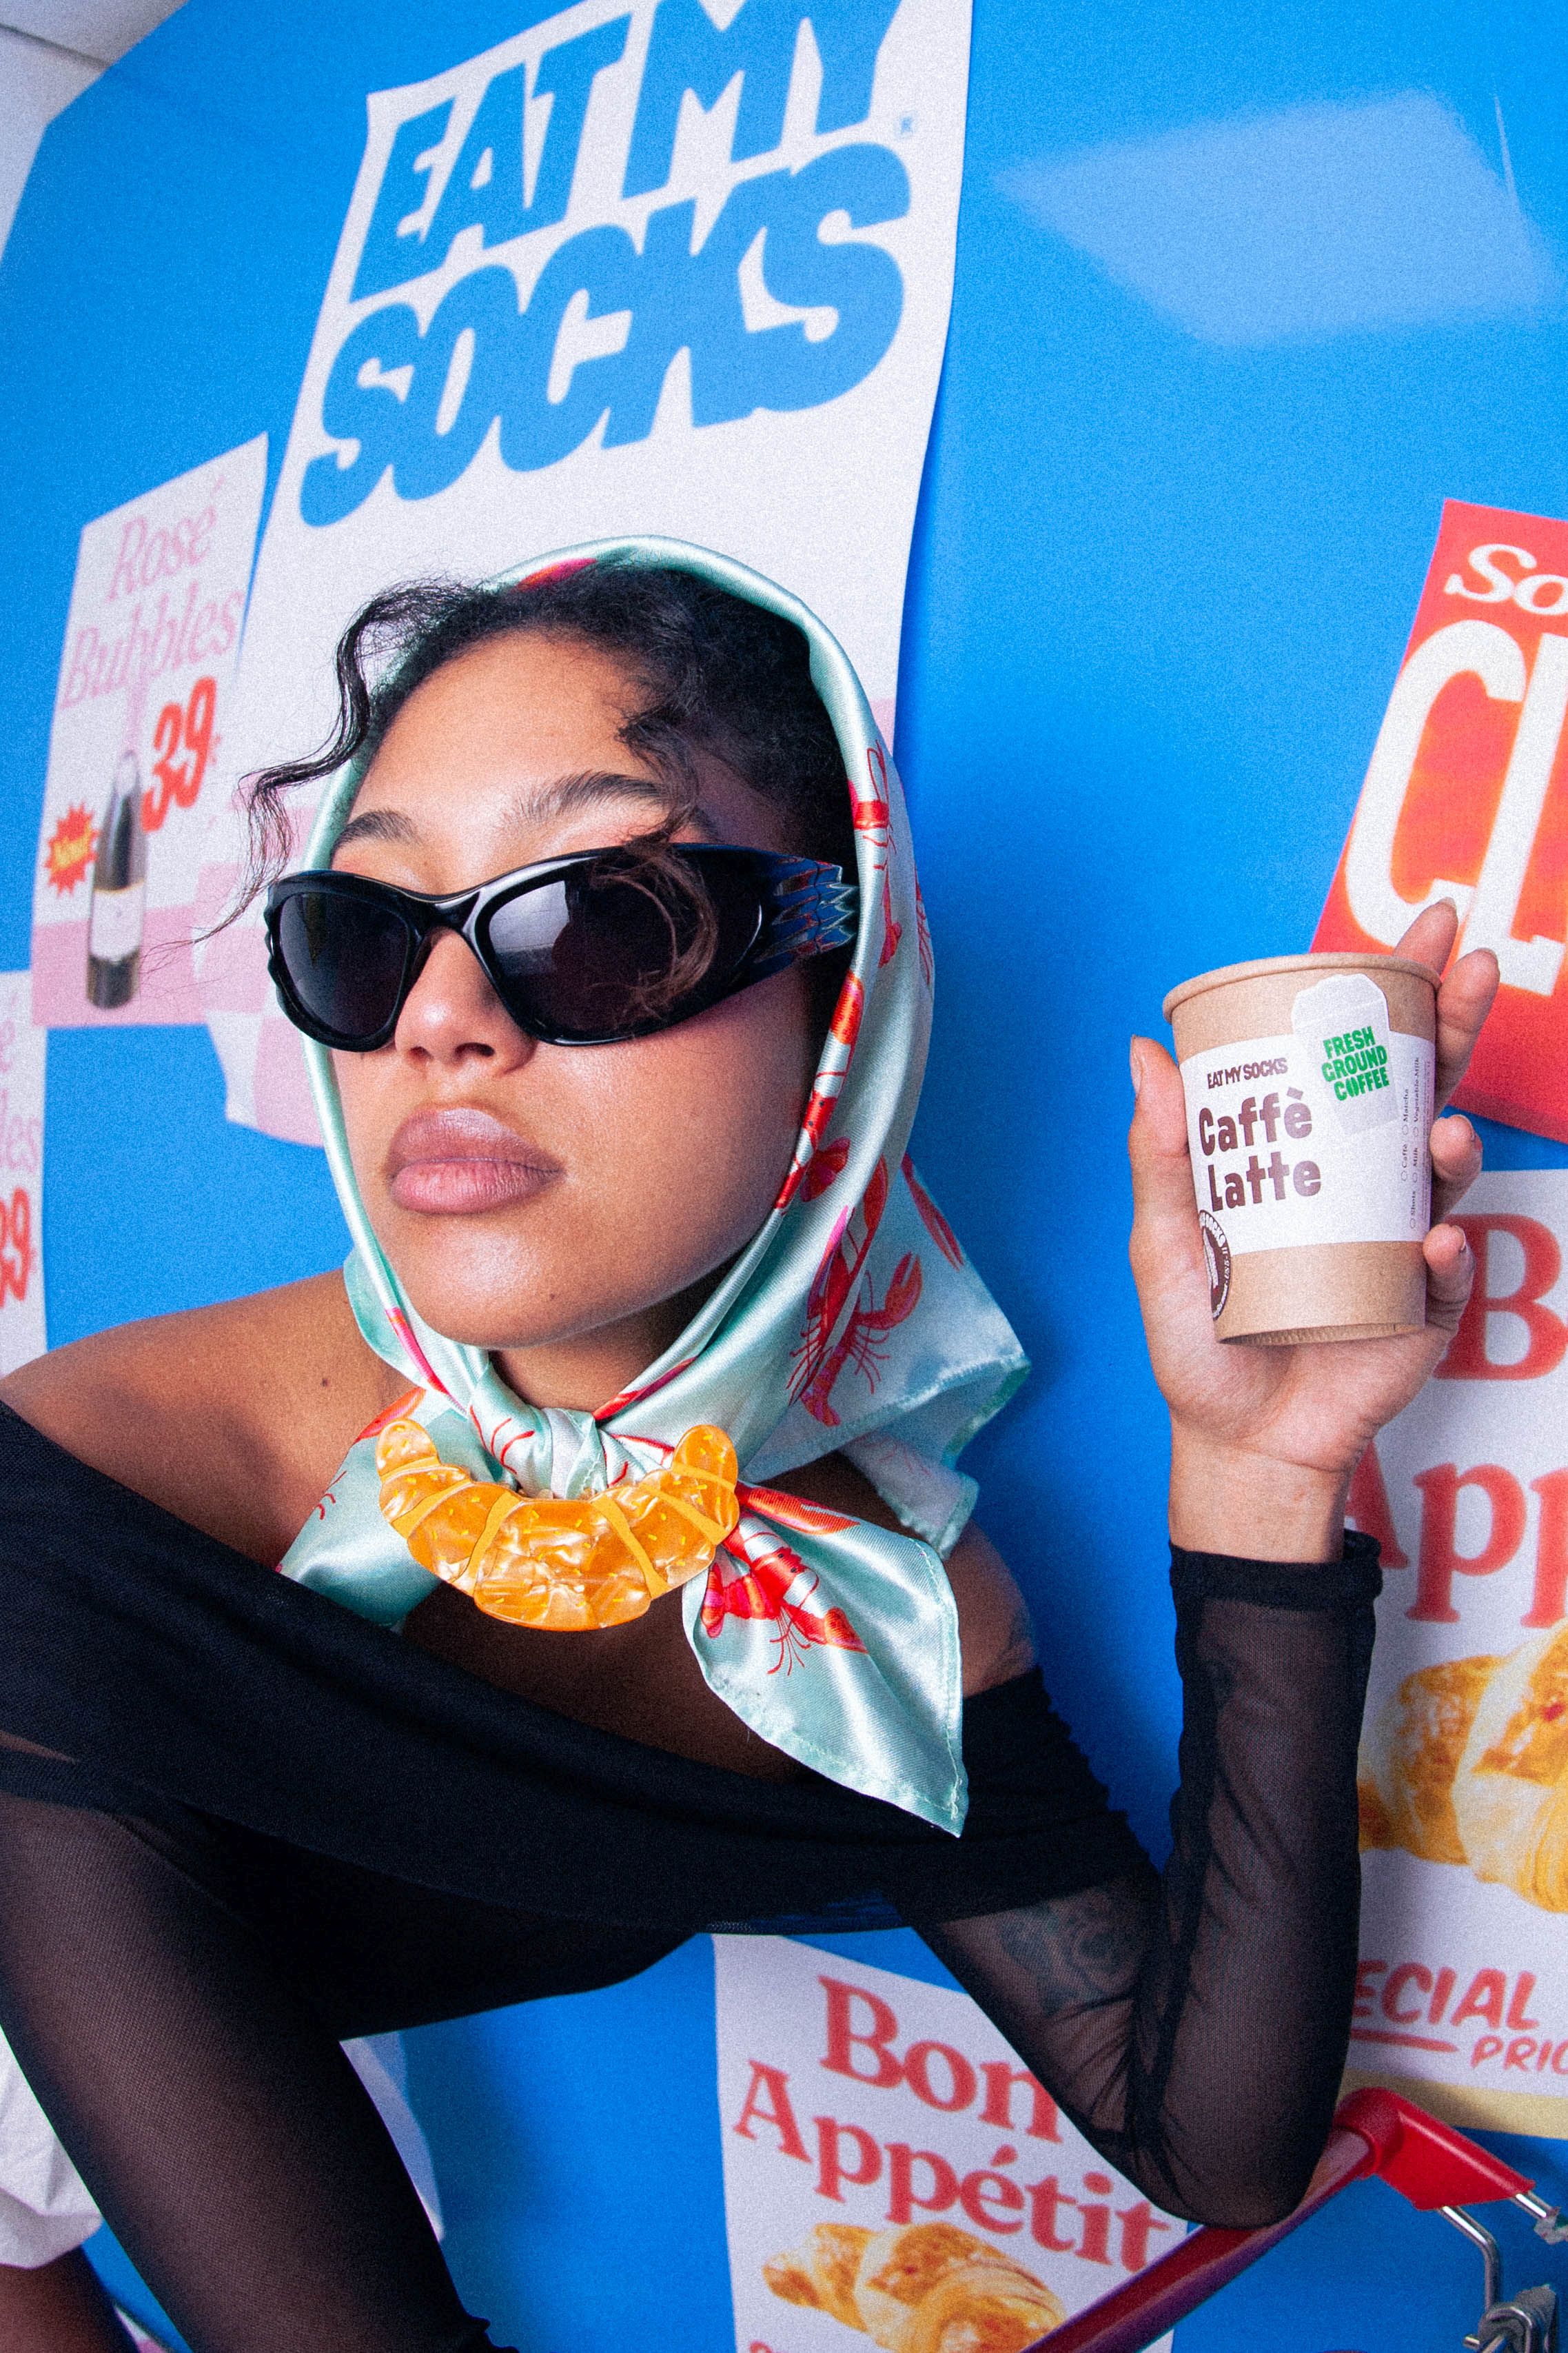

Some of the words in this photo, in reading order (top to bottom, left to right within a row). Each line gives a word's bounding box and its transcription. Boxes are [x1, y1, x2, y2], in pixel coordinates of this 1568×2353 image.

[349, 12, 633, 305] EAT
[620, 0, 902, 201] MY
[299, 141, 912, 528] SOCKS
[105, 476, 225, 605] Rosé
[60, 579, 247, 711] Bubbles
[140, 675, 217, 833] 39
[1207, 1069, 1223, 1089] EAT
[1225, 1066, 1242, 1085] MY
[1243, 1058, 1288, 1080] SOCKS
[1321, 1045, 1388, 1082] GROUND
[1323, 1026, 1376, 1060] FRESH
[1334, 1067, 1389, 1101] COFFEE
[1199, 1086, 1313, 1157] Caffè
[1208, 1151, 1322, 1212] Latte
[0, 1187, 30, 1307] 9
[1352, 1959, 1540, 2031] ECIAL
[817, 1975, 1063, 2145] Bon
[1469, 2035, 1568, 2074] PRIC
[733, 2059, 1171, 2274] Appétit
